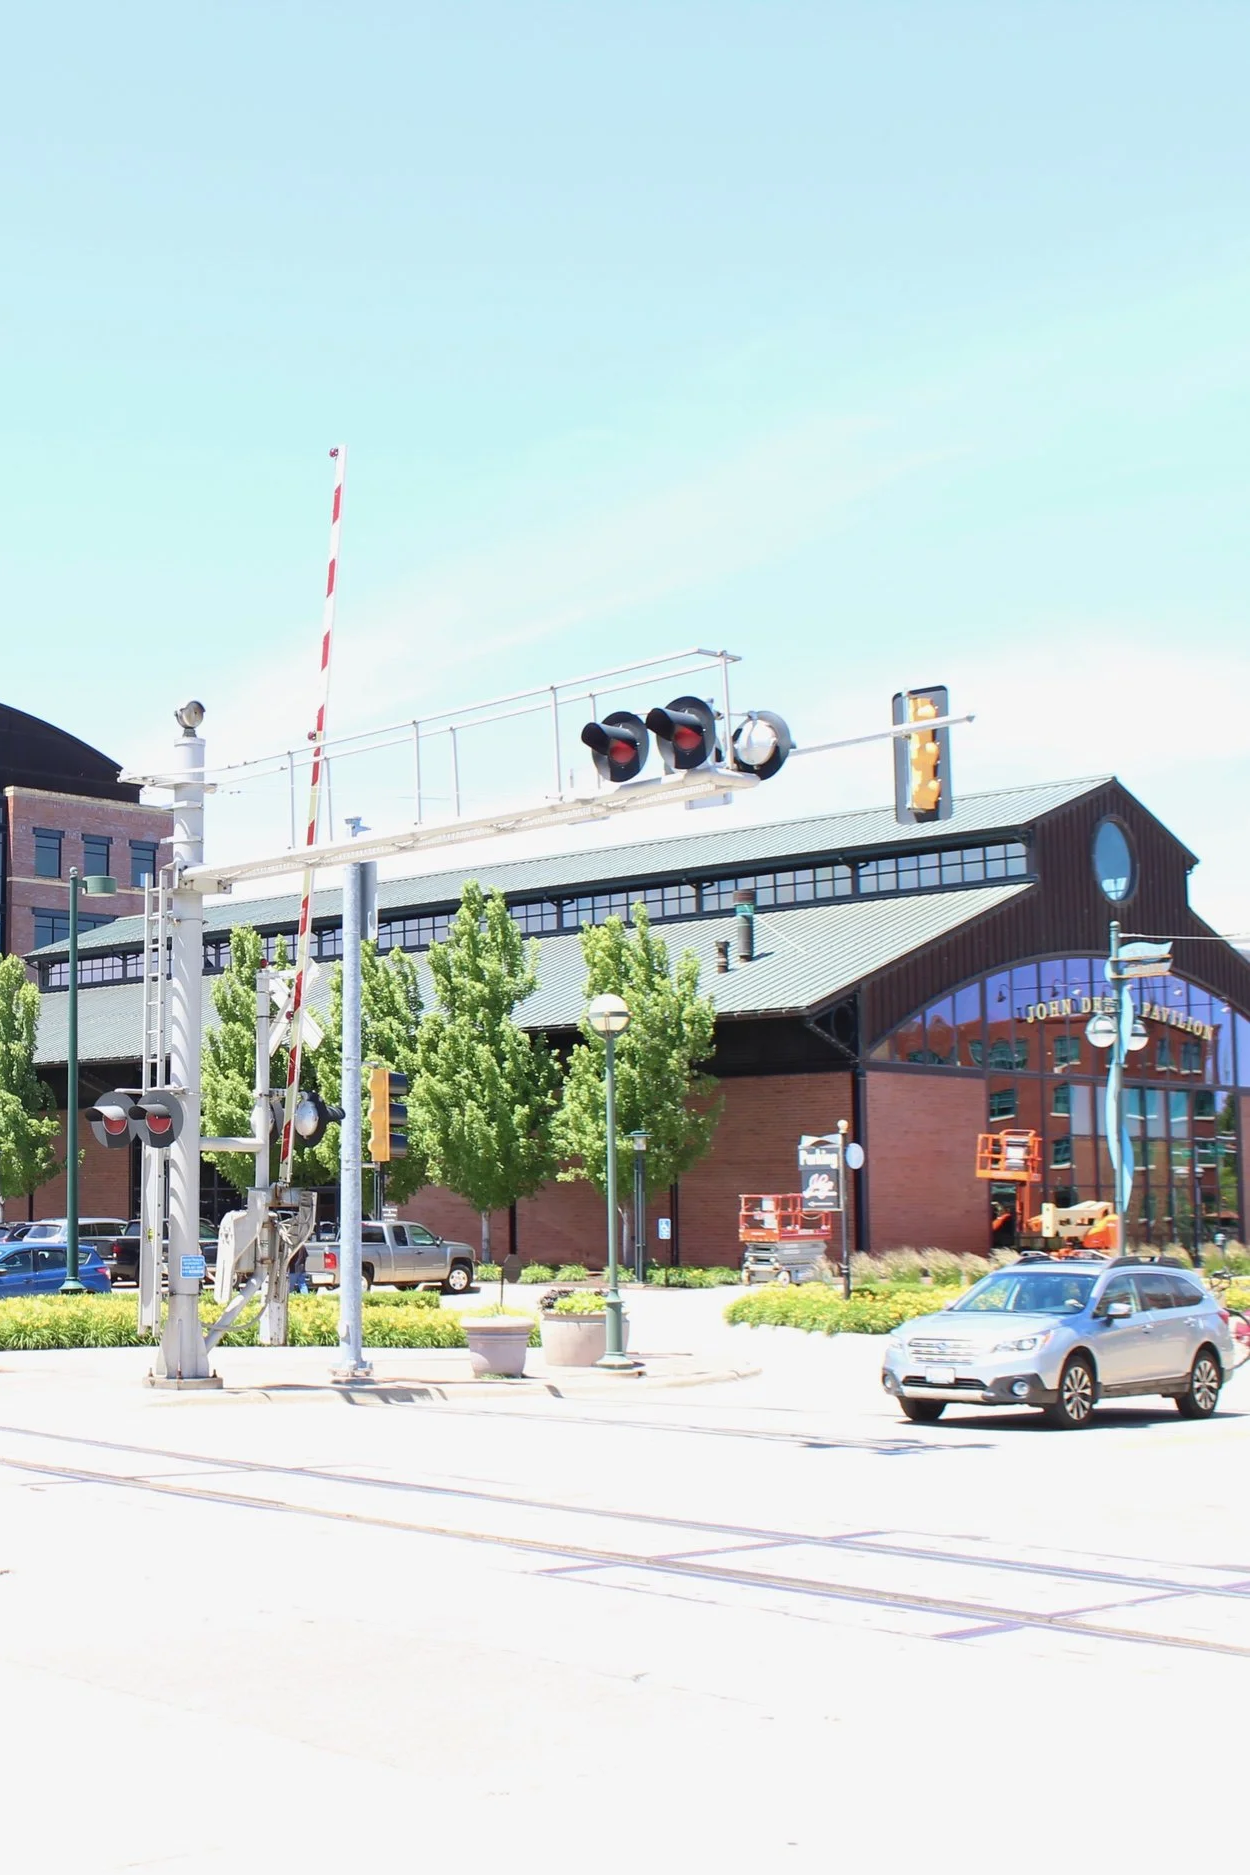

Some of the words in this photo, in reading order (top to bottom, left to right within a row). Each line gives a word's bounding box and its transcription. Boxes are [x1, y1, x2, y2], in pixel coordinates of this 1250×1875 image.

[1026, 998, 1072, 1024] JOHN
[1141, 1001, 1215, 1041] PAVILION
[799, 1148, 838, 1169] Parking
